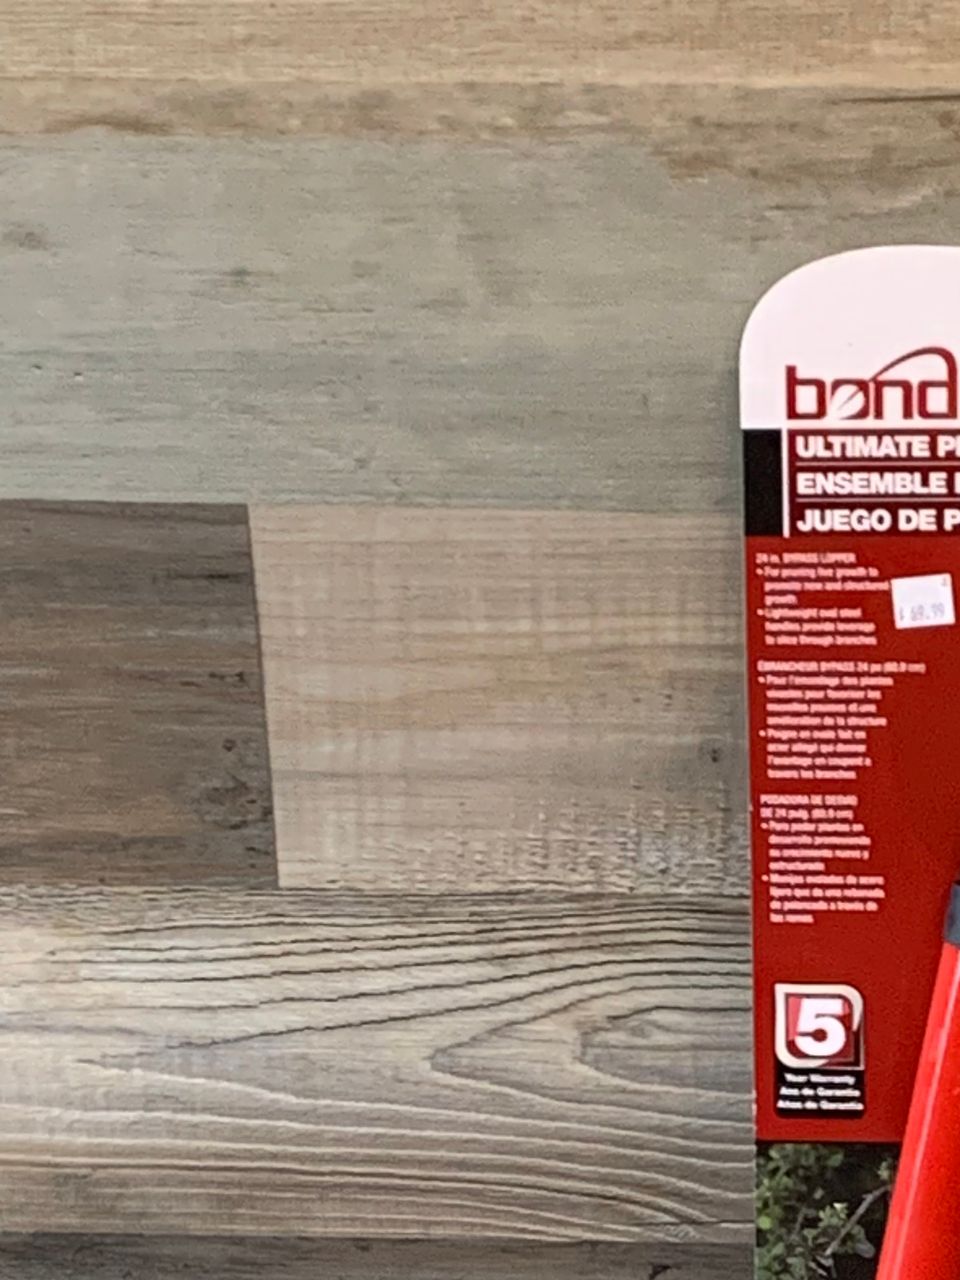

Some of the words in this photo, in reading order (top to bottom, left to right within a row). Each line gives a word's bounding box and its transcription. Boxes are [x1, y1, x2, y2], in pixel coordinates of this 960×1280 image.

[786, 347, 958, 420] bond
[796, 435, 930, 458] ULTIMATE
[796, 471, 948, 494] ENSEMBLE
[797, 509, 892, 532] JUEGO
[898, 509, 937, 532] DE
[795, 997, 846, 1057] 5
